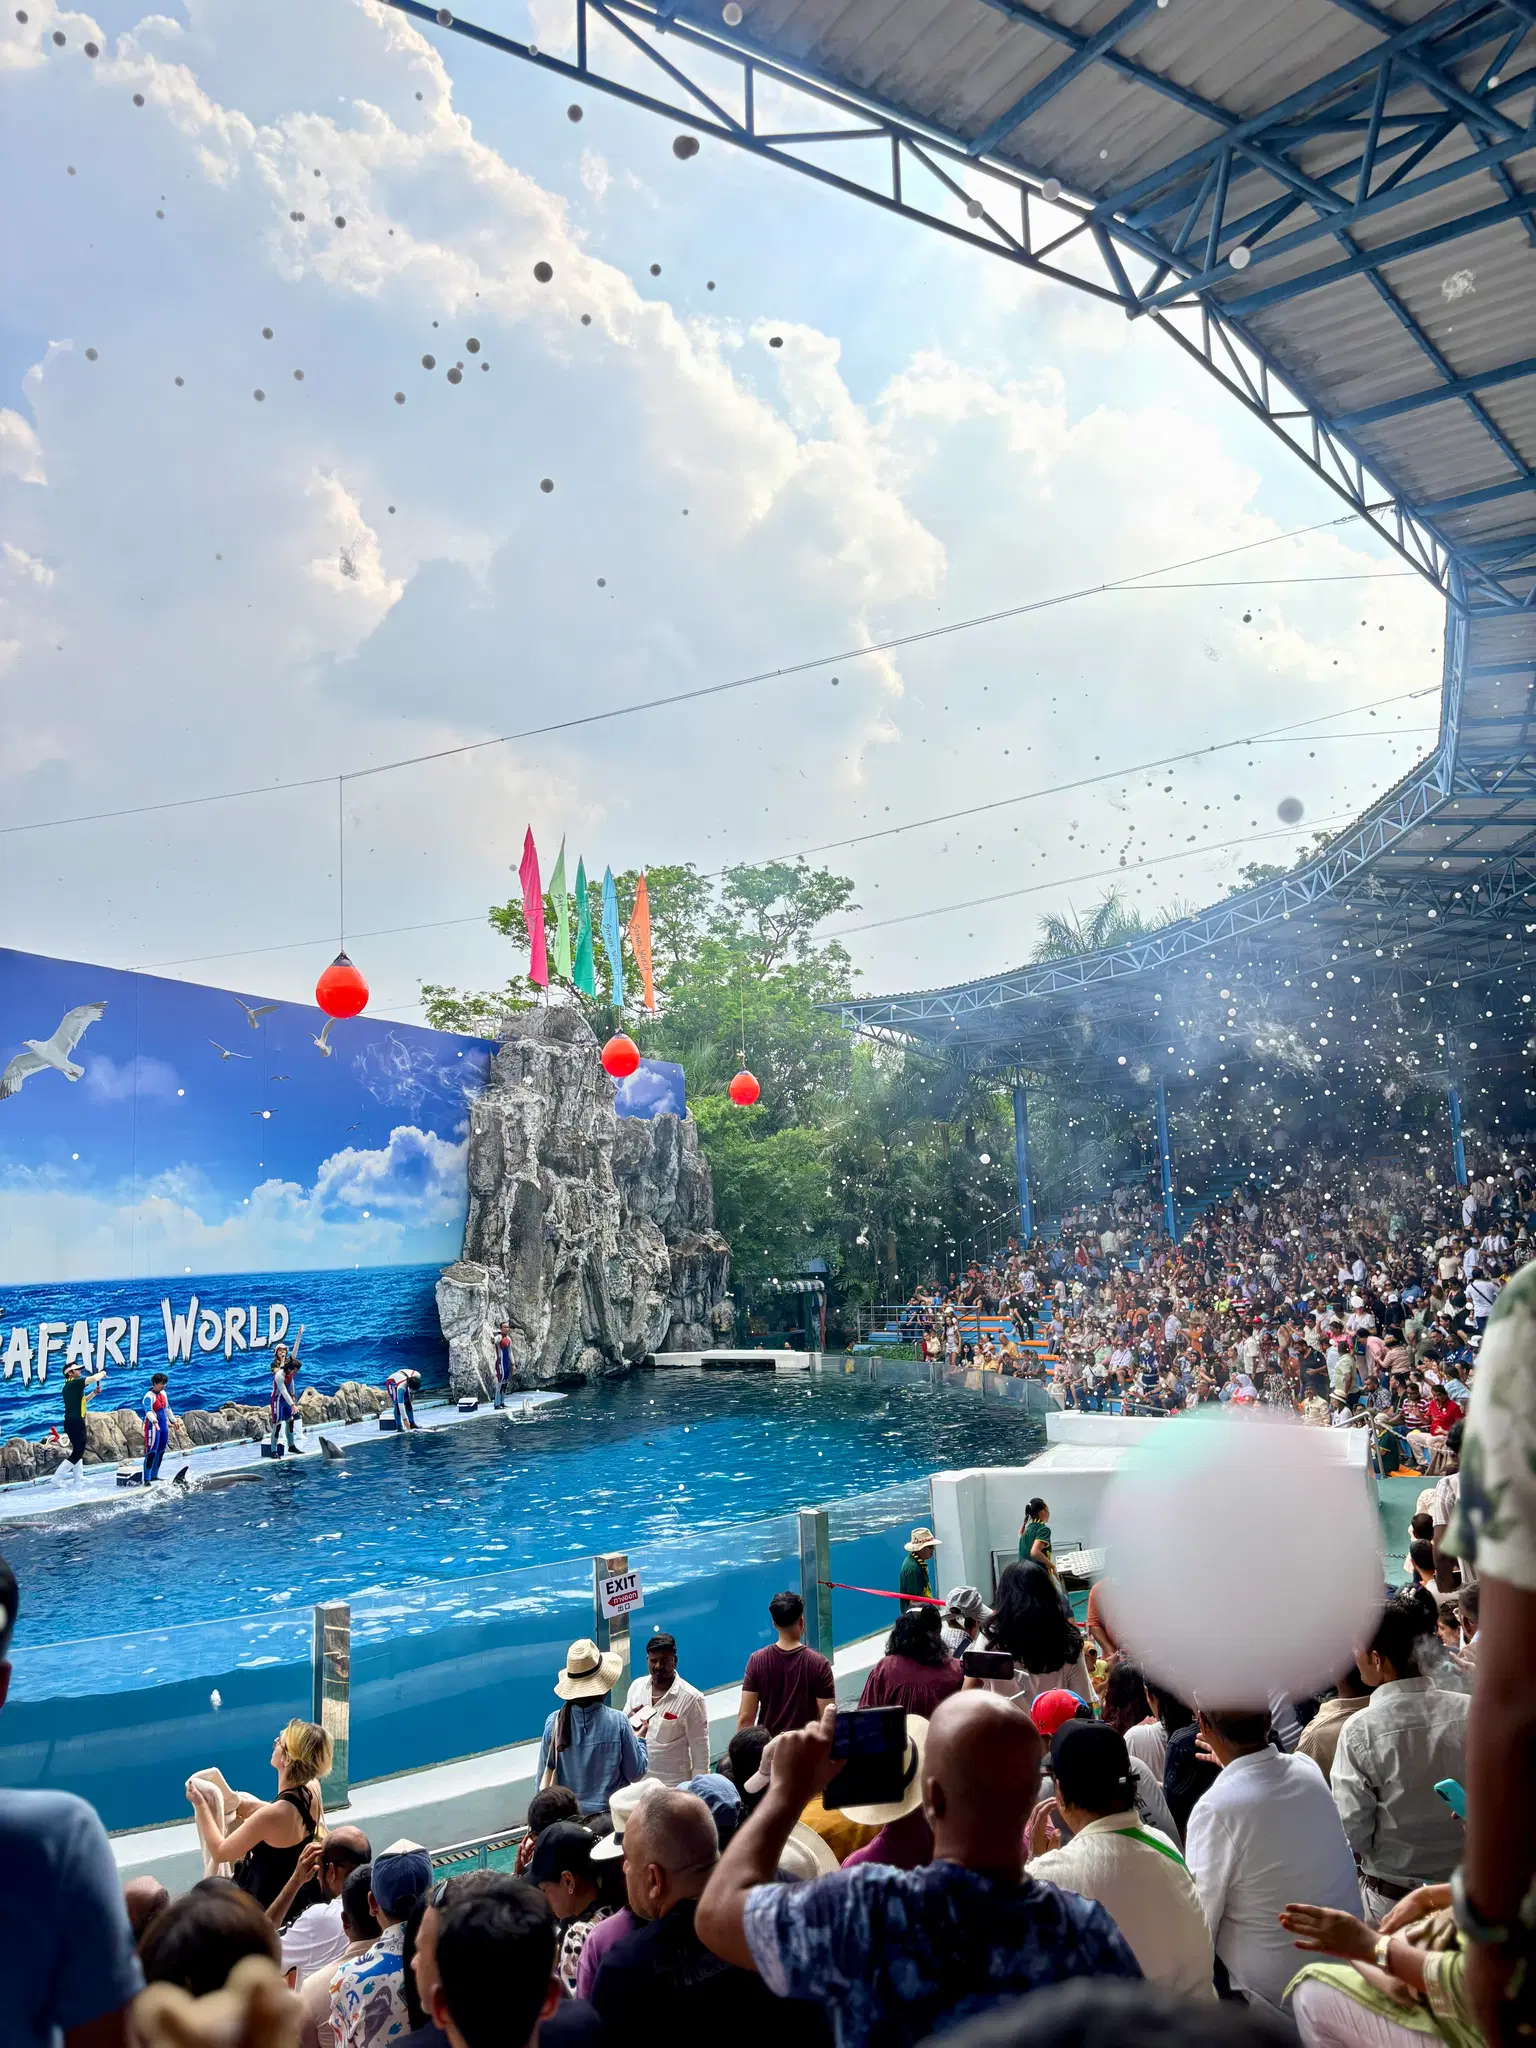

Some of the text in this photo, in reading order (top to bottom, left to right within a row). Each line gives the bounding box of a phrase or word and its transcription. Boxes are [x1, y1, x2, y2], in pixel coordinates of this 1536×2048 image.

[0, 1294, 289, 1387] AFARI WORLD
[606, 1575, 636, 1595] EXIT
[613, 1592, 637, 1604] ทางออก
[618, 1603, 630, 1612] 出口
